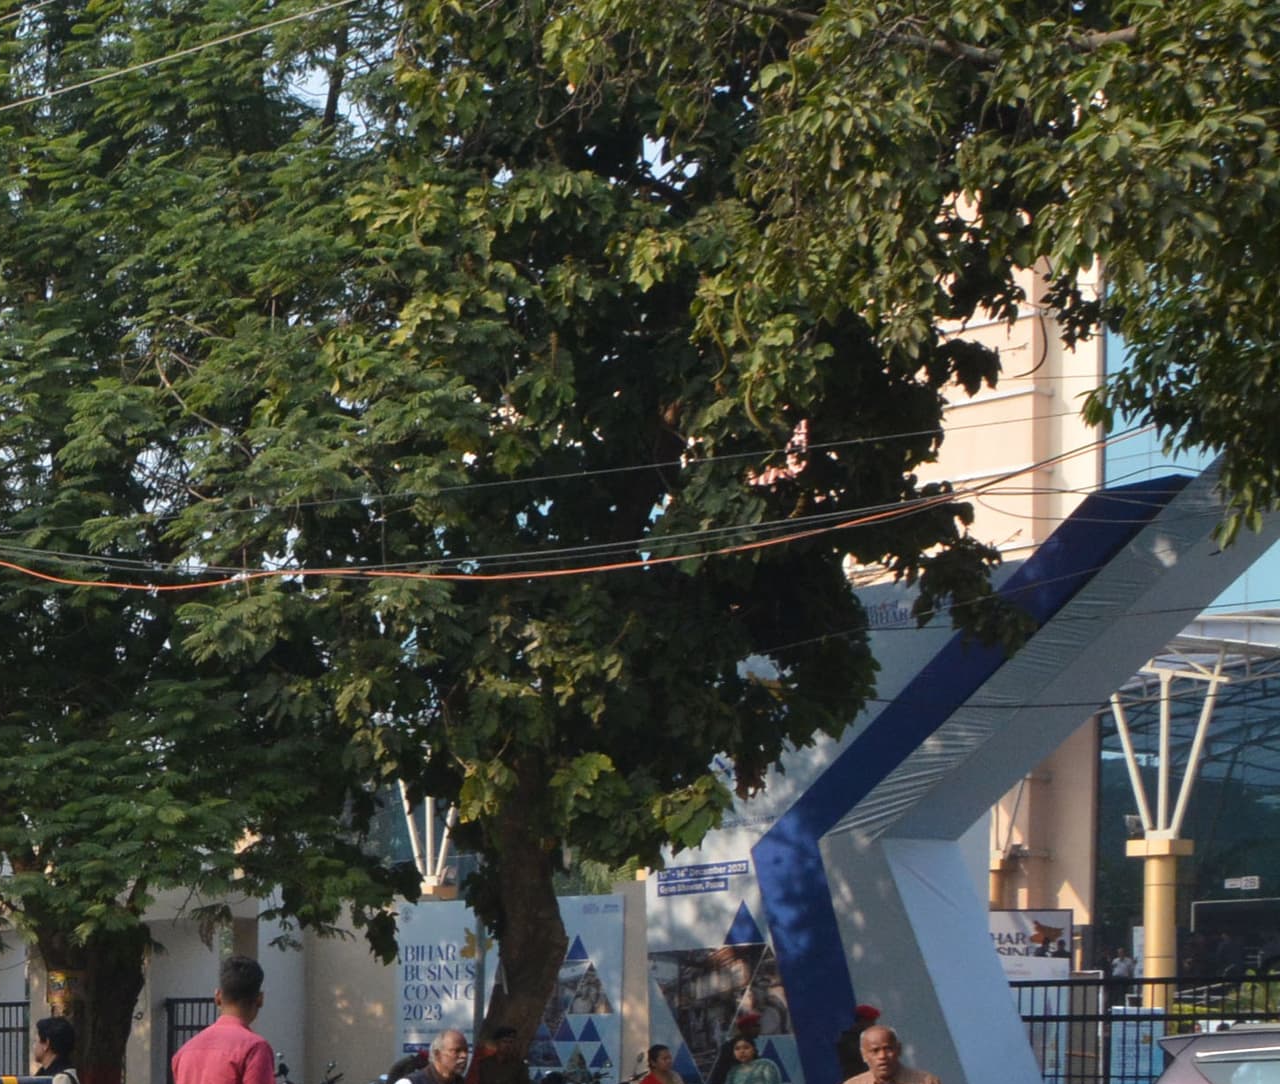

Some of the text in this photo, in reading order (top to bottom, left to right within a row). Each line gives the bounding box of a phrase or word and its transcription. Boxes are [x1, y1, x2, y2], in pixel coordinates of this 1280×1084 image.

[404, 943, 457, 962] BIHAR
[404, 963, 475, 982] BUSINES
[404, 983, 475, 1001] CONNEC
[403, 1004, 442, 1021] 2023
